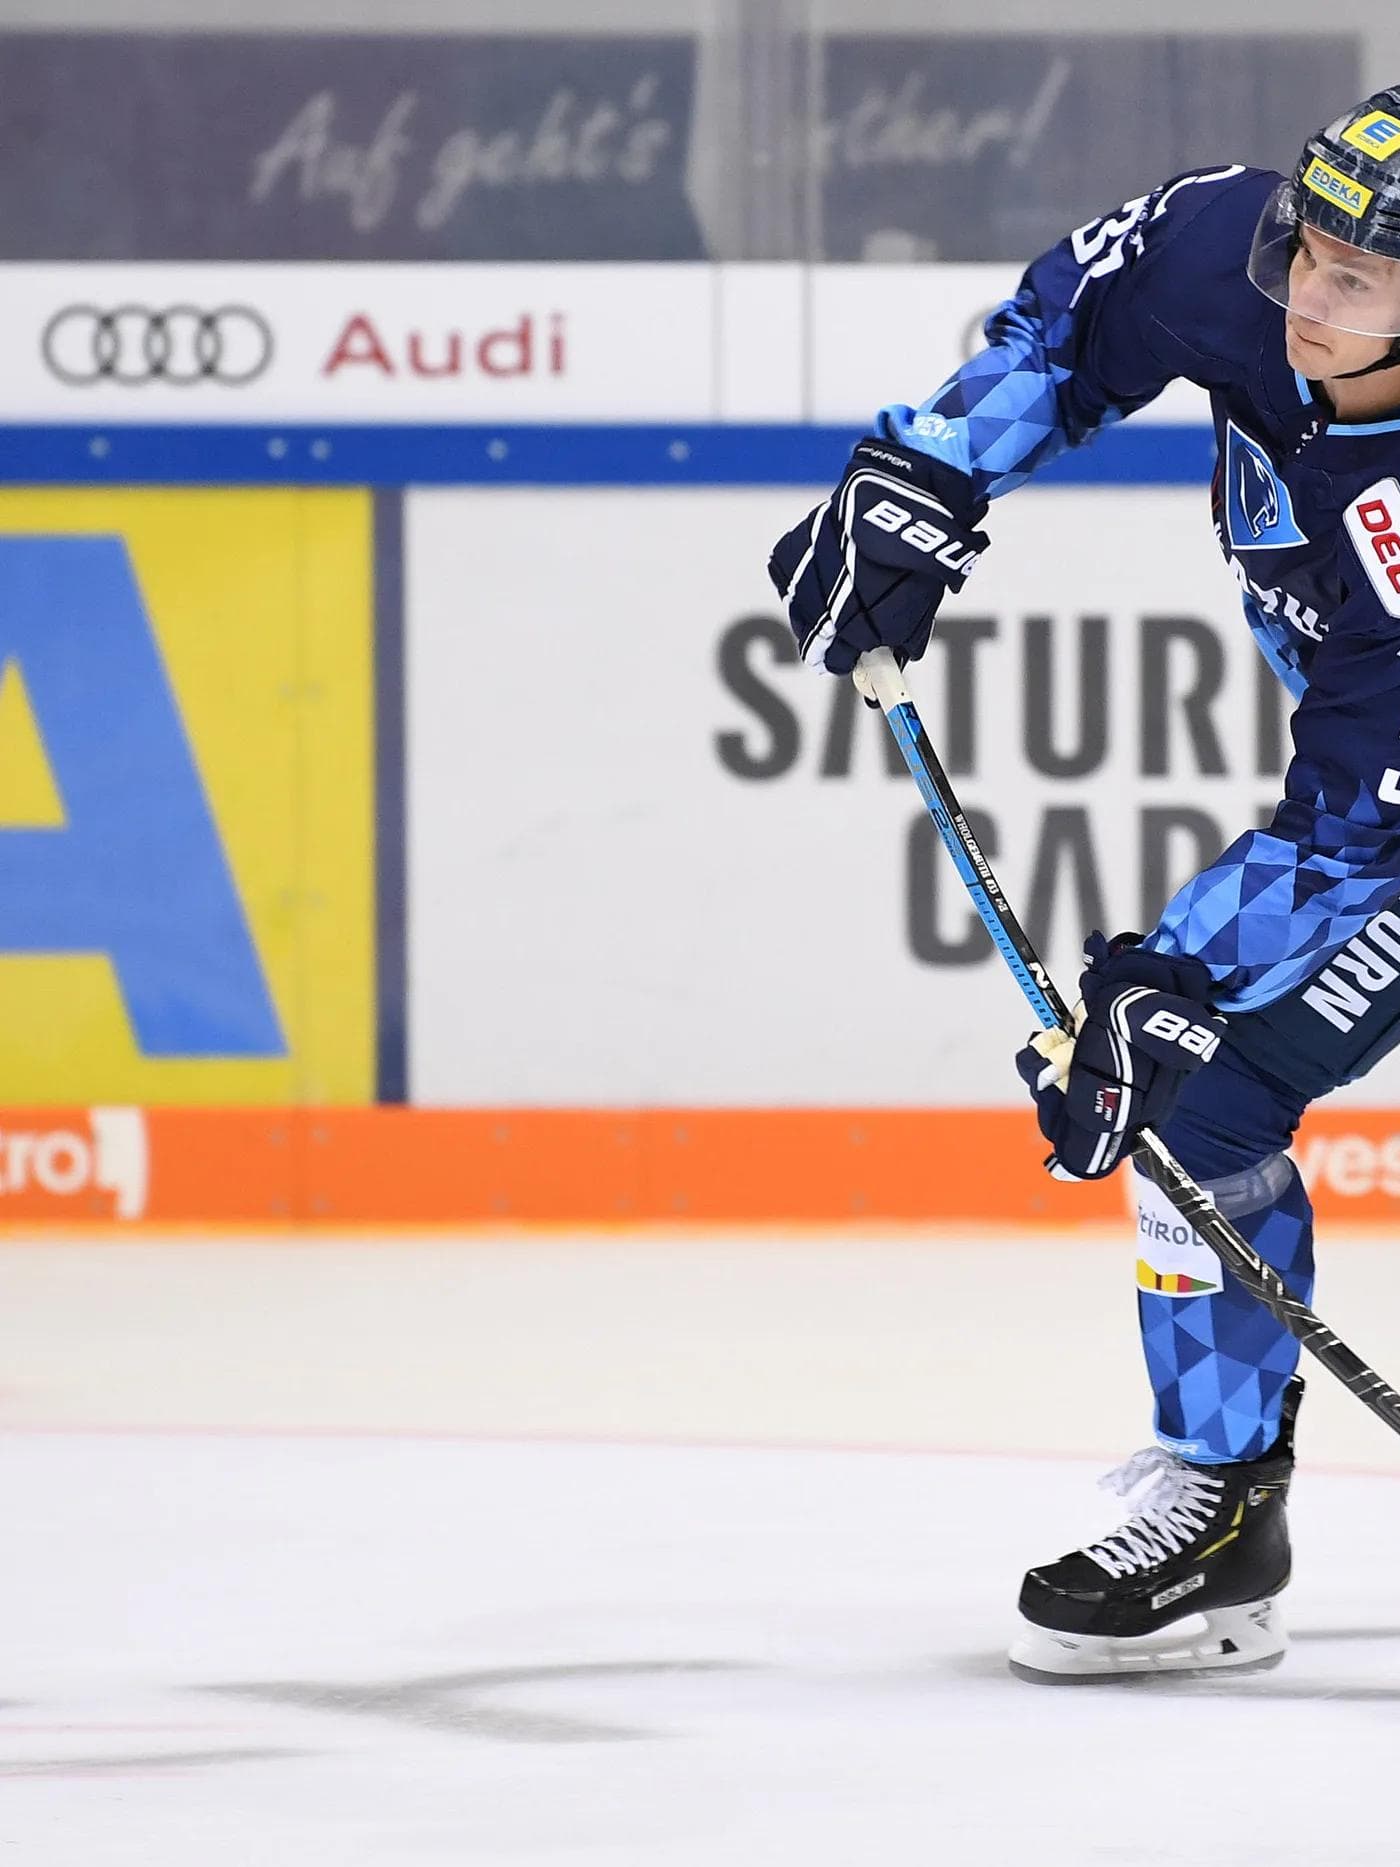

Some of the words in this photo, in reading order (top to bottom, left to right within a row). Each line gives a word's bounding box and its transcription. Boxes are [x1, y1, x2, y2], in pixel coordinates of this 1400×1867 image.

[1310, 165, 1364, 207] EDEKA
[322, 312, 567, 378] Audi
[714, 613, 1284, 782] SATUR
[908, 806, 1290, 968] CAR
